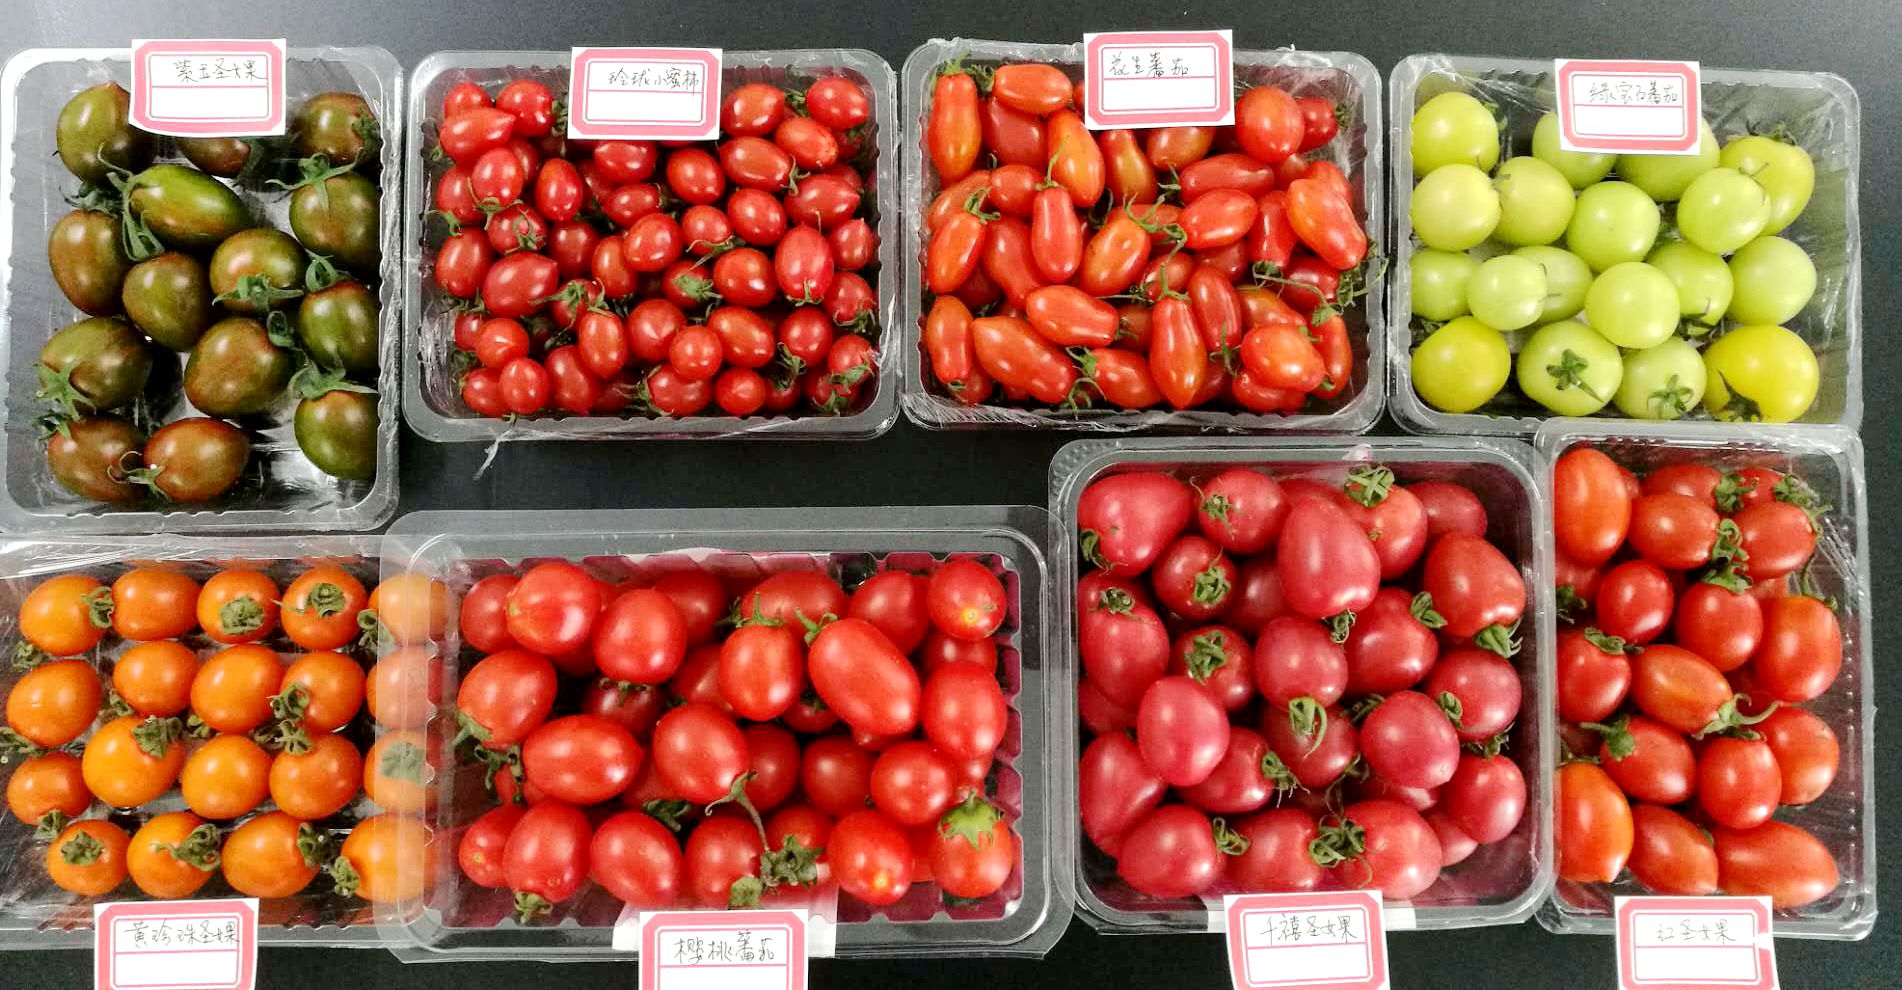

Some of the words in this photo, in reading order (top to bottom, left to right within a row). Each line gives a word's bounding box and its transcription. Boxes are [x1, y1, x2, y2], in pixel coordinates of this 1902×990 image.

[1260, 913, 1358, 945] 千禧圣女果
[1656, 919, 1737, 945] 红圣女果
